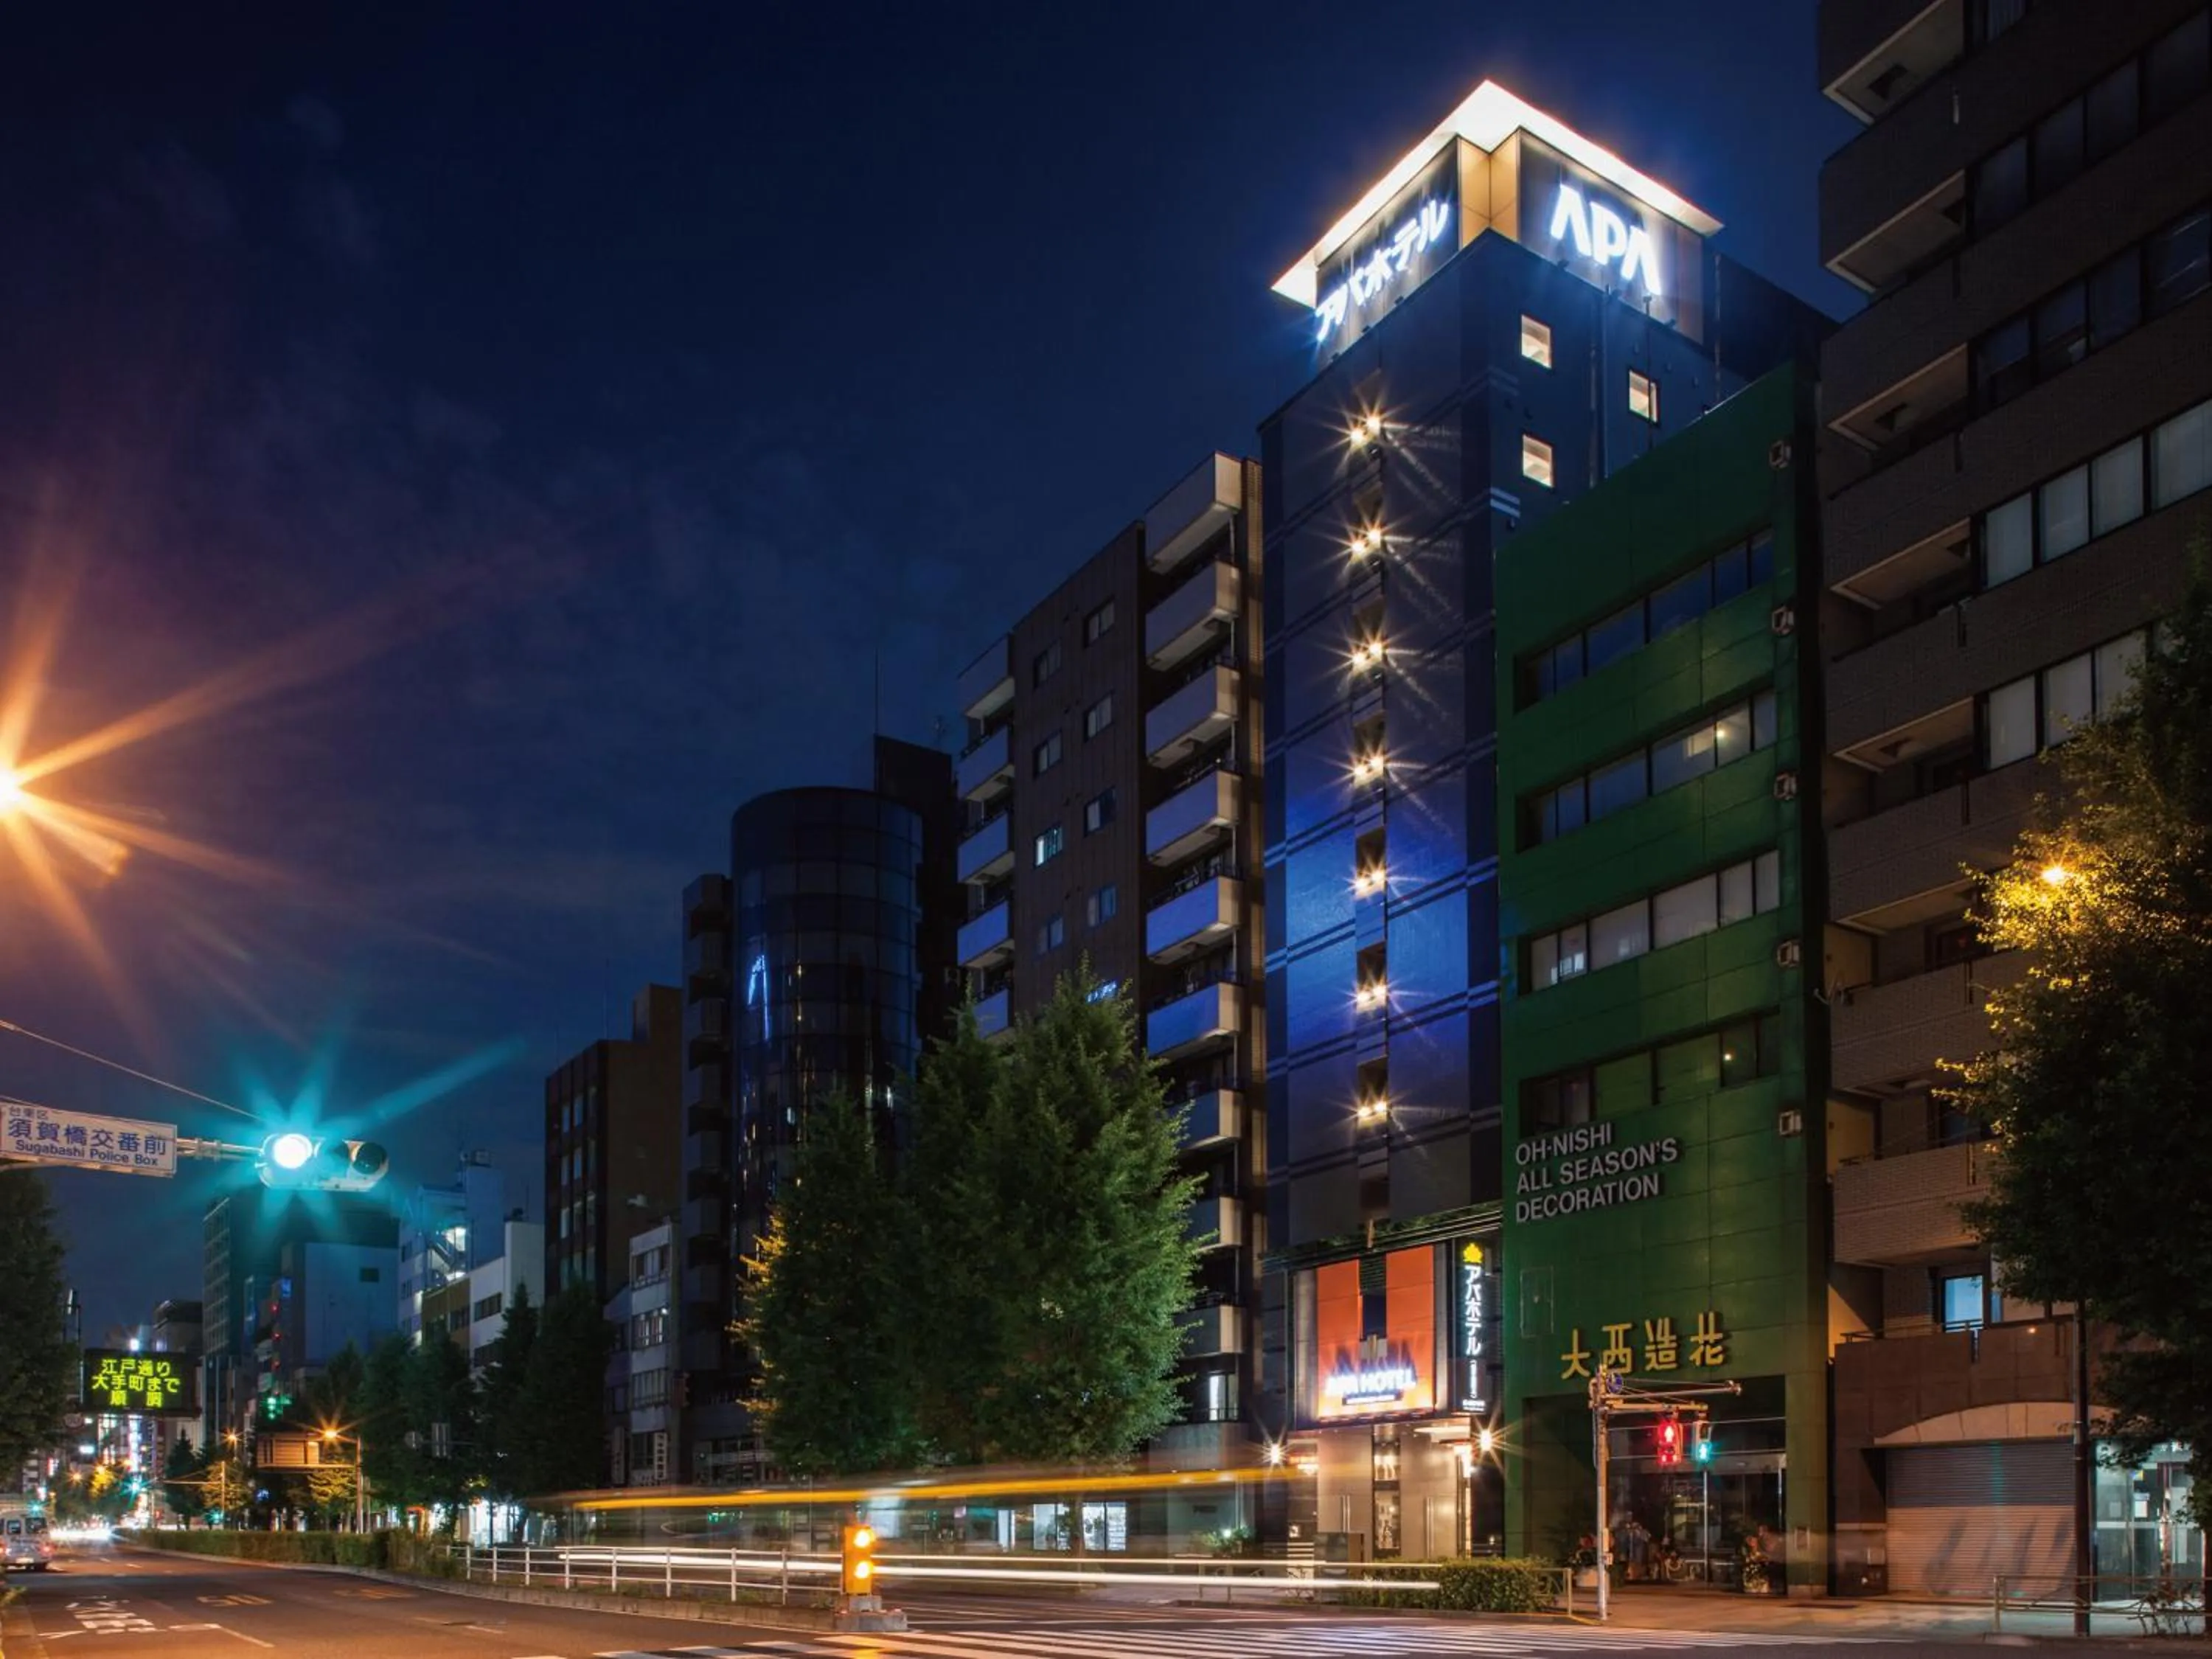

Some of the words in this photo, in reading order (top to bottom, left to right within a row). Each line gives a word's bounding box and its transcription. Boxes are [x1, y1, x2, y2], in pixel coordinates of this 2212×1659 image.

[1551, 184, 1661, 295] APA
[8, 1118, 166, 1155] 須賀橋交番前
[15, 1139, 85, 1158] Sugabashi
[89, 1148, 129, 1164] Police
[134, 1153, 159, 1166] Box
[1515, 1121, 1612, 1165] OH-NISHI
[1516, 1167, 1553, 1195] ALL
[1559, 1137, 1678, 1185] SEASON'S
[1515, 1172, 1658, 1224] DECORATION
[102, 1358, 171, 1377] 江戸通り
[1561, 1311, 1724, 1380] 大西造花
[91, 1374, 181, 1393] 大手町まで
